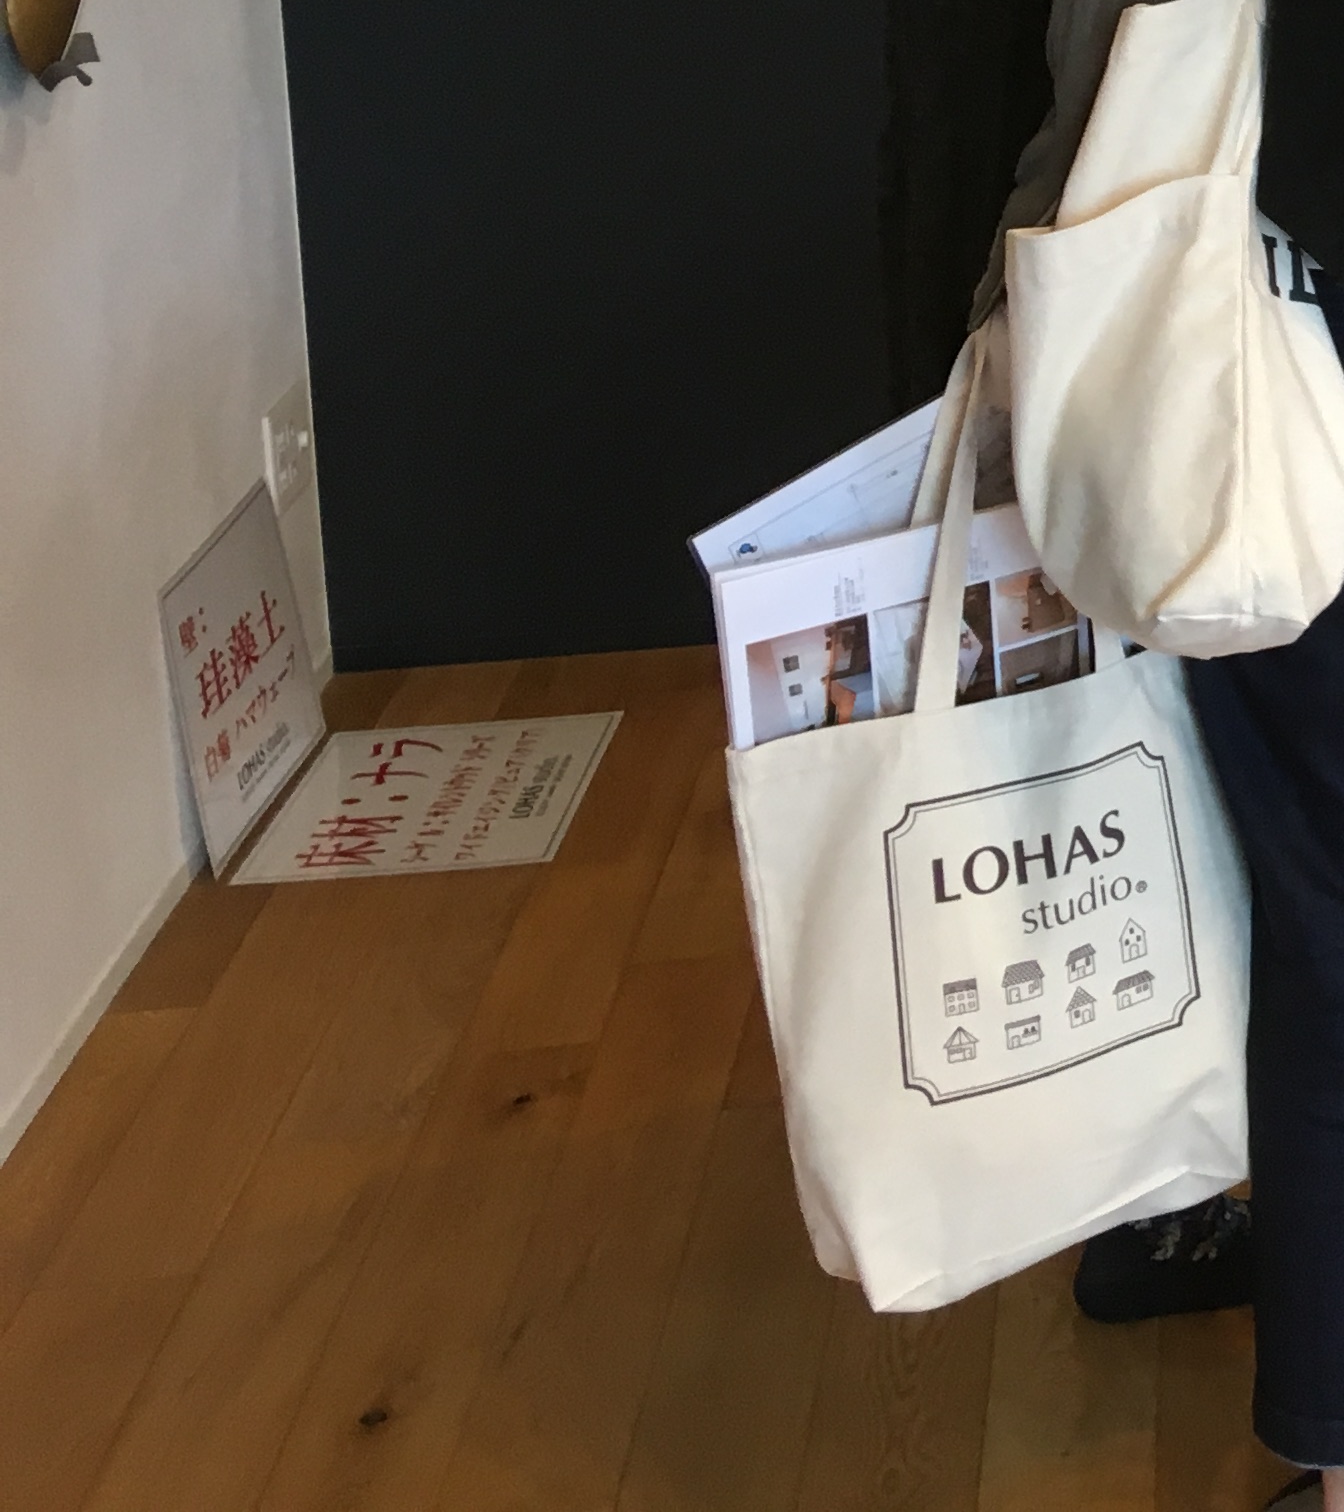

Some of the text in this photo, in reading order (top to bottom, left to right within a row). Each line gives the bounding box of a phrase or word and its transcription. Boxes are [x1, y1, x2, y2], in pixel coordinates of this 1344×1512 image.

[196, 590, 285, 719] 珪藻土
[931, 808, 1126, 905] LOHAS
